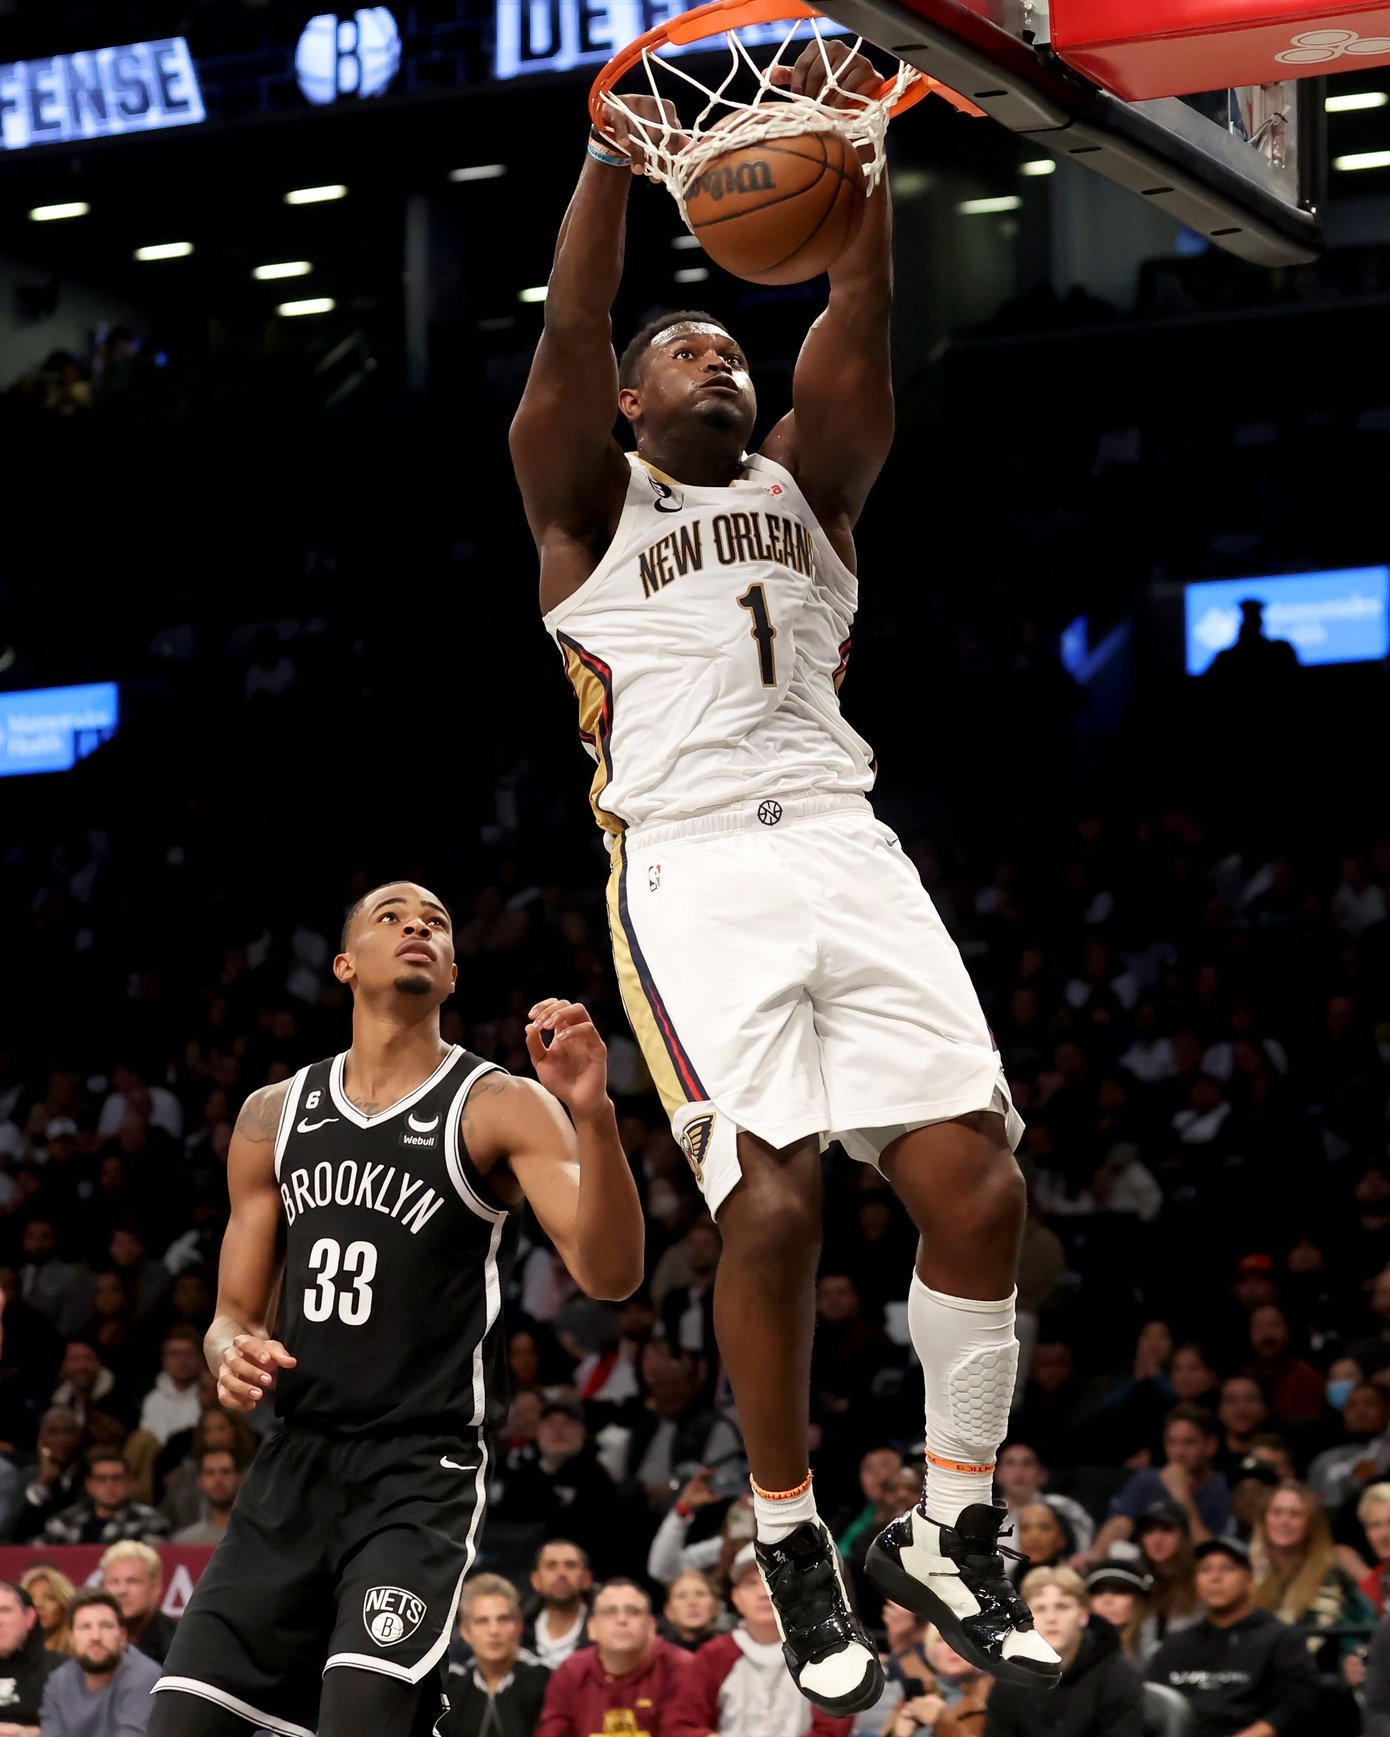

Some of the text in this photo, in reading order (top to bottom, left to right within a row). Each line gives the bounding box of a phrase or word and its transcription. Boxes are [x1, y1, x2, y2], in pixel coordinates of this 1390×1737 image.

[638, 511, 814, 600] NEW ORLEAN
[736, 582, 777, 688] 1
[305, 1090, 321, 1110] 6
[403, 1134, 435, 1147] Webull
[280, 1160, 445, 1235] BROOKLYN
[303, 1237, 378, 1326] 33
[365, 1589, 422, 1624] NETS
[381, 1616, 394, 1638] B
